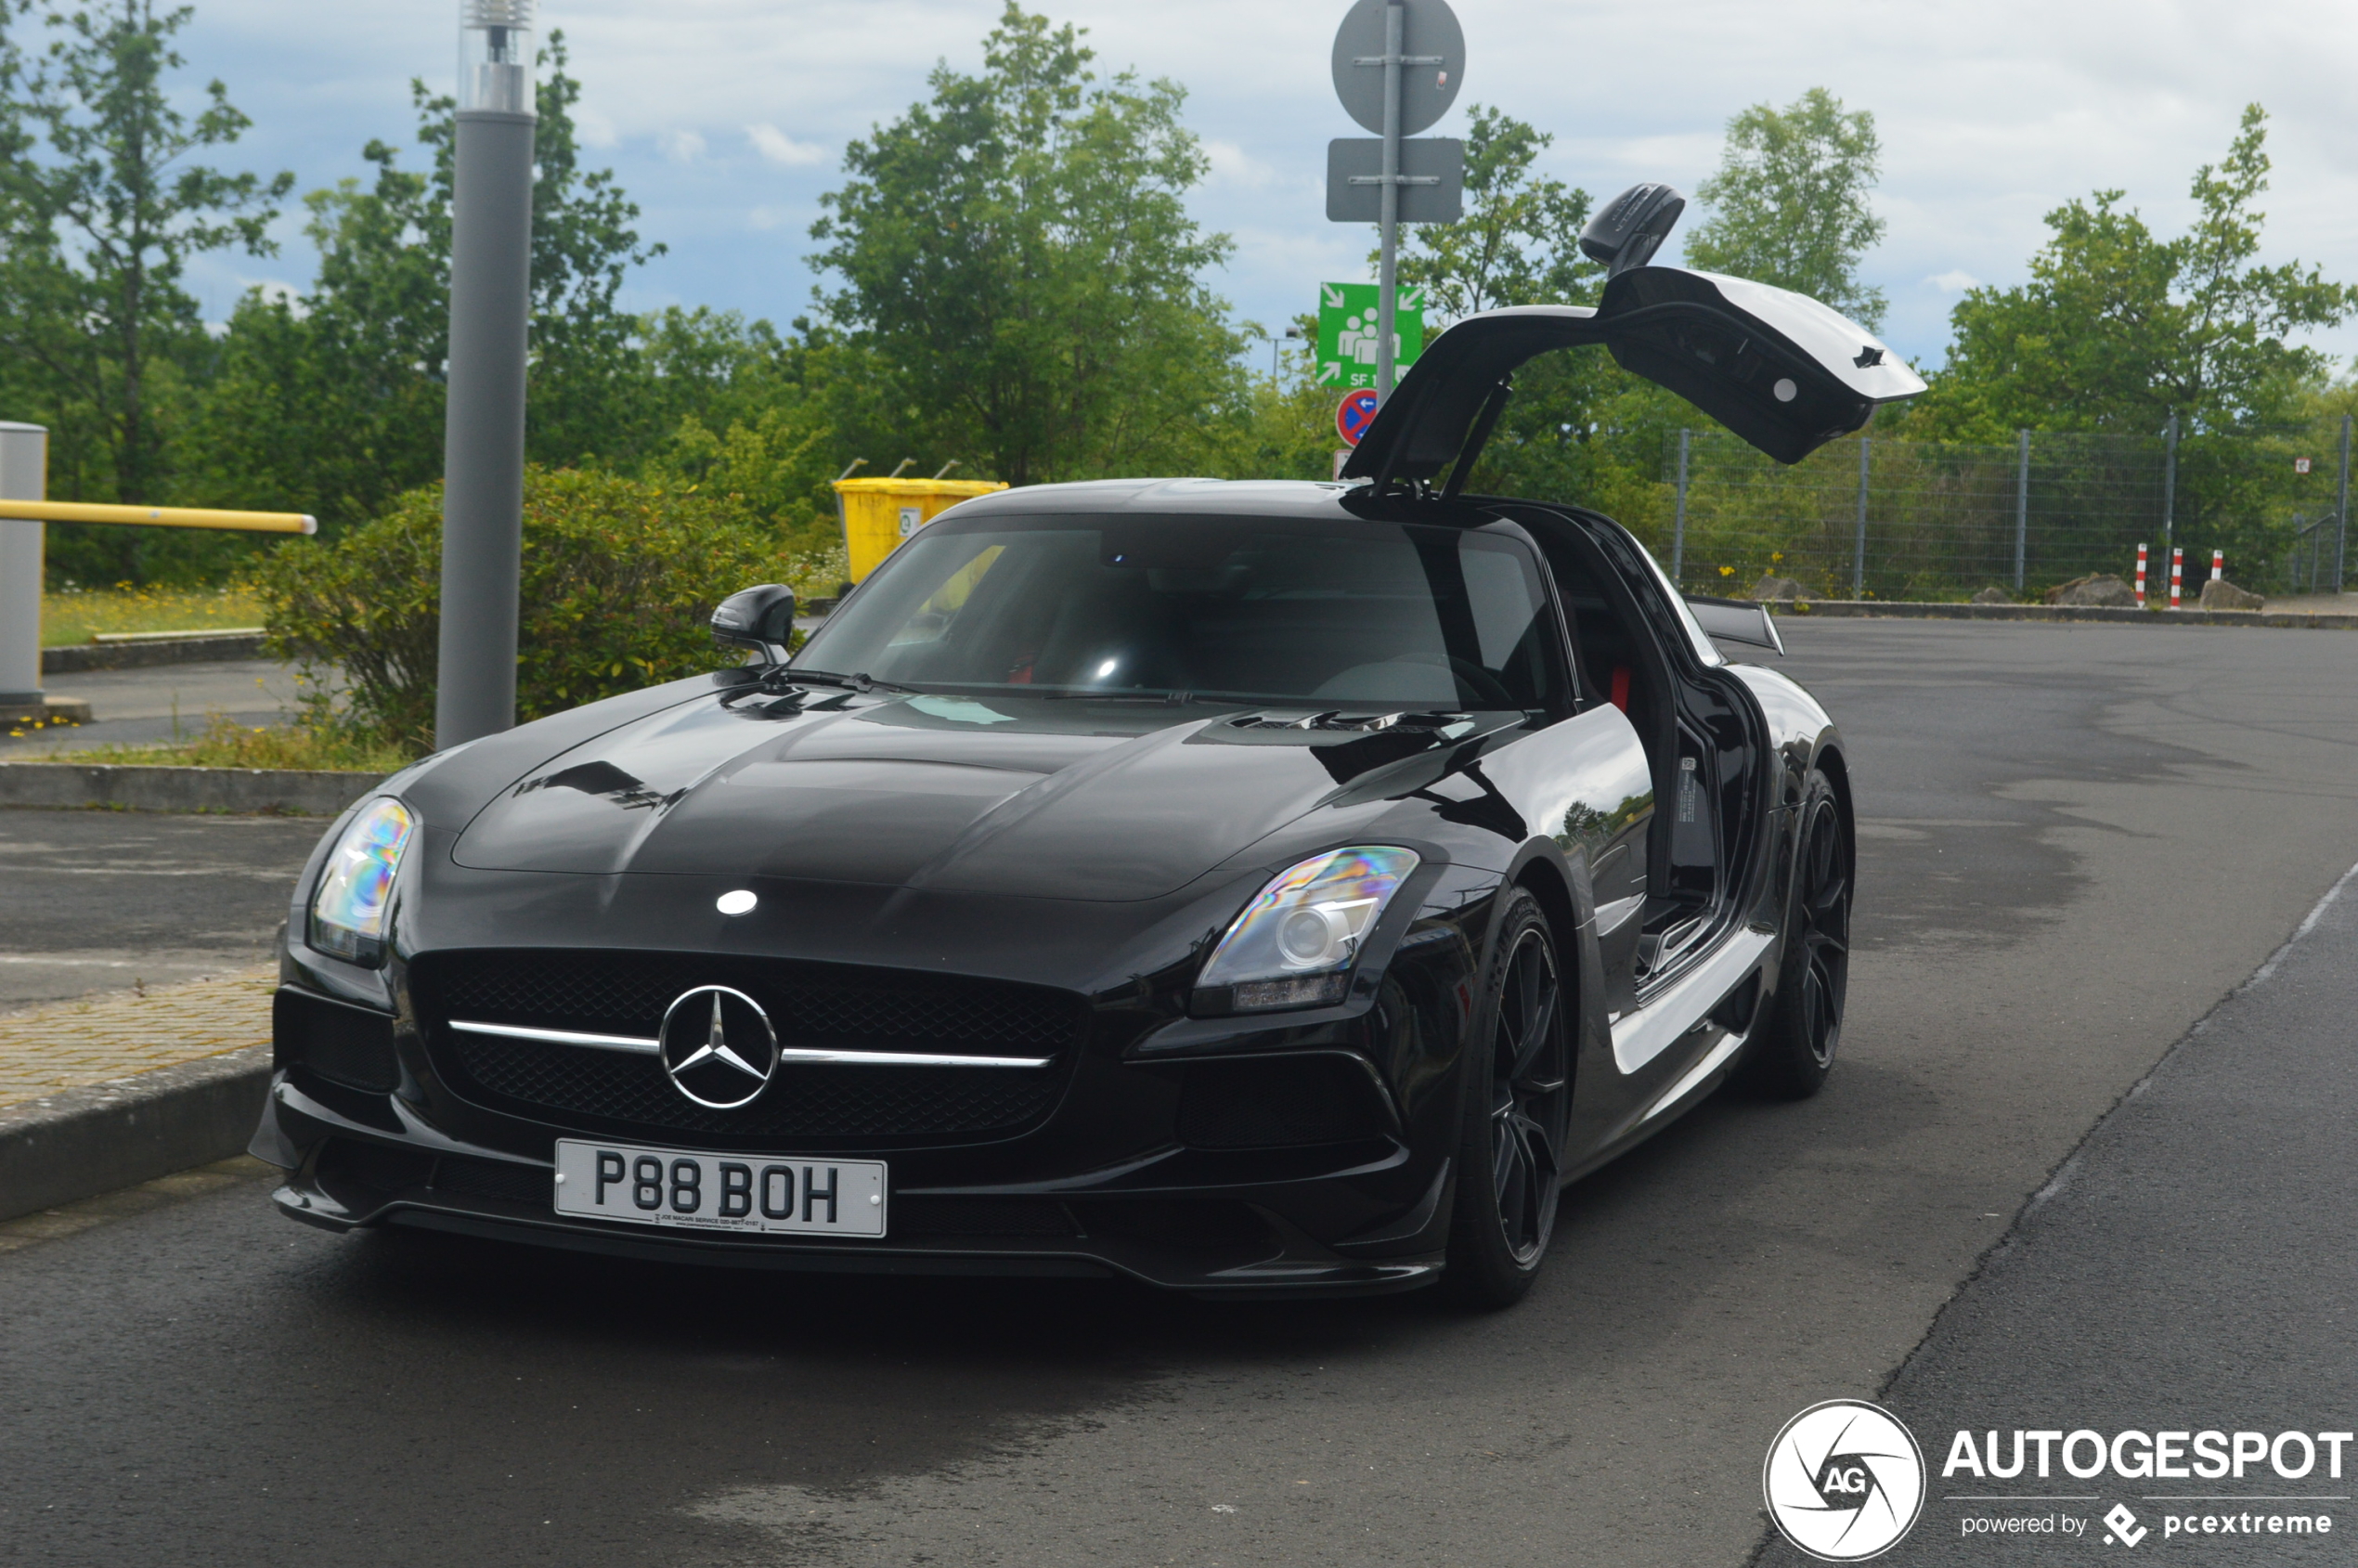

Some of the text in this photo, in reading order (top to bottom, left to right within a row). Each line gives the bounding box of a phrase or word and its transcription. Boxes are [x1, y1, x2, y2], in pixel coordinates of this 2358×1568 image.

[1350, 373, 1368, 386] SF
[595, 1149, 838, 1224] P88 BOH
